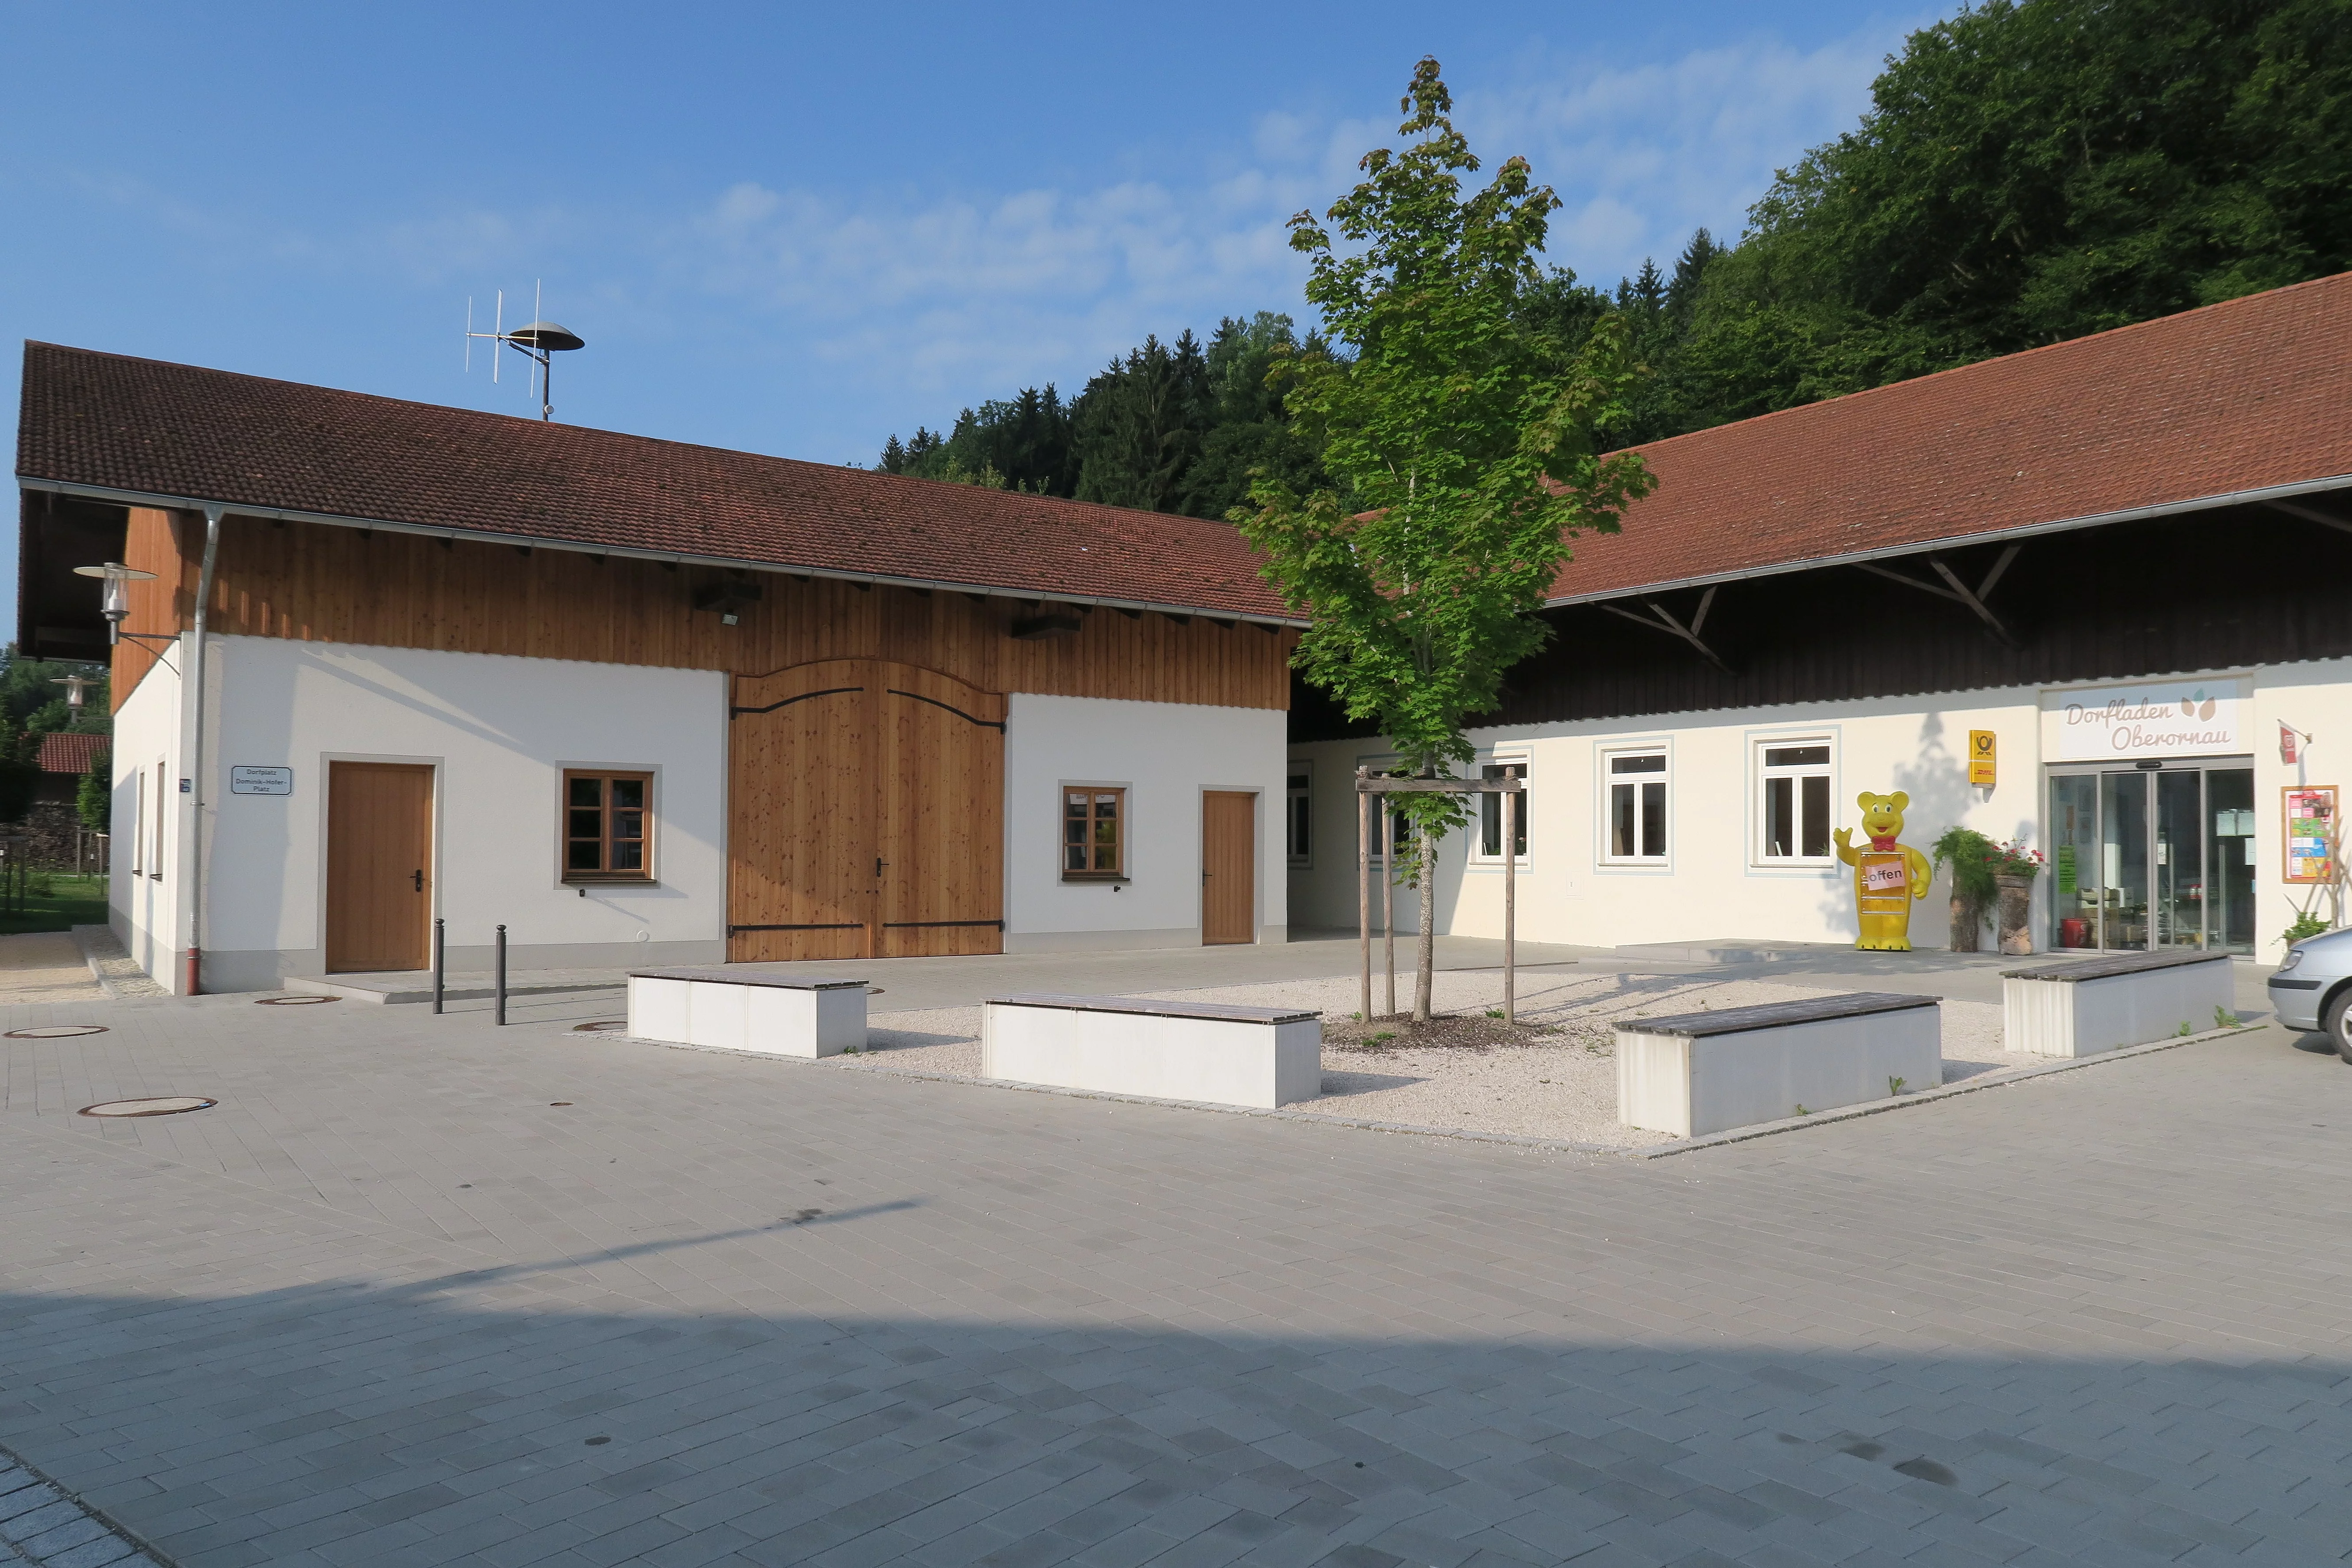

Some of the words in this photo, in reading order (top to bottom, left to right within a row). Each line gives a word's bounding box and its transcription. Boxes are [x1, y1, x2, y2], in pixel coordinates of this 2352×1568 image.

[2065, 697, 2174, 729] Dorfladen
[2112, 724, 2231, 751] Oberornau
[1870, 870, 1902, 882] offen
